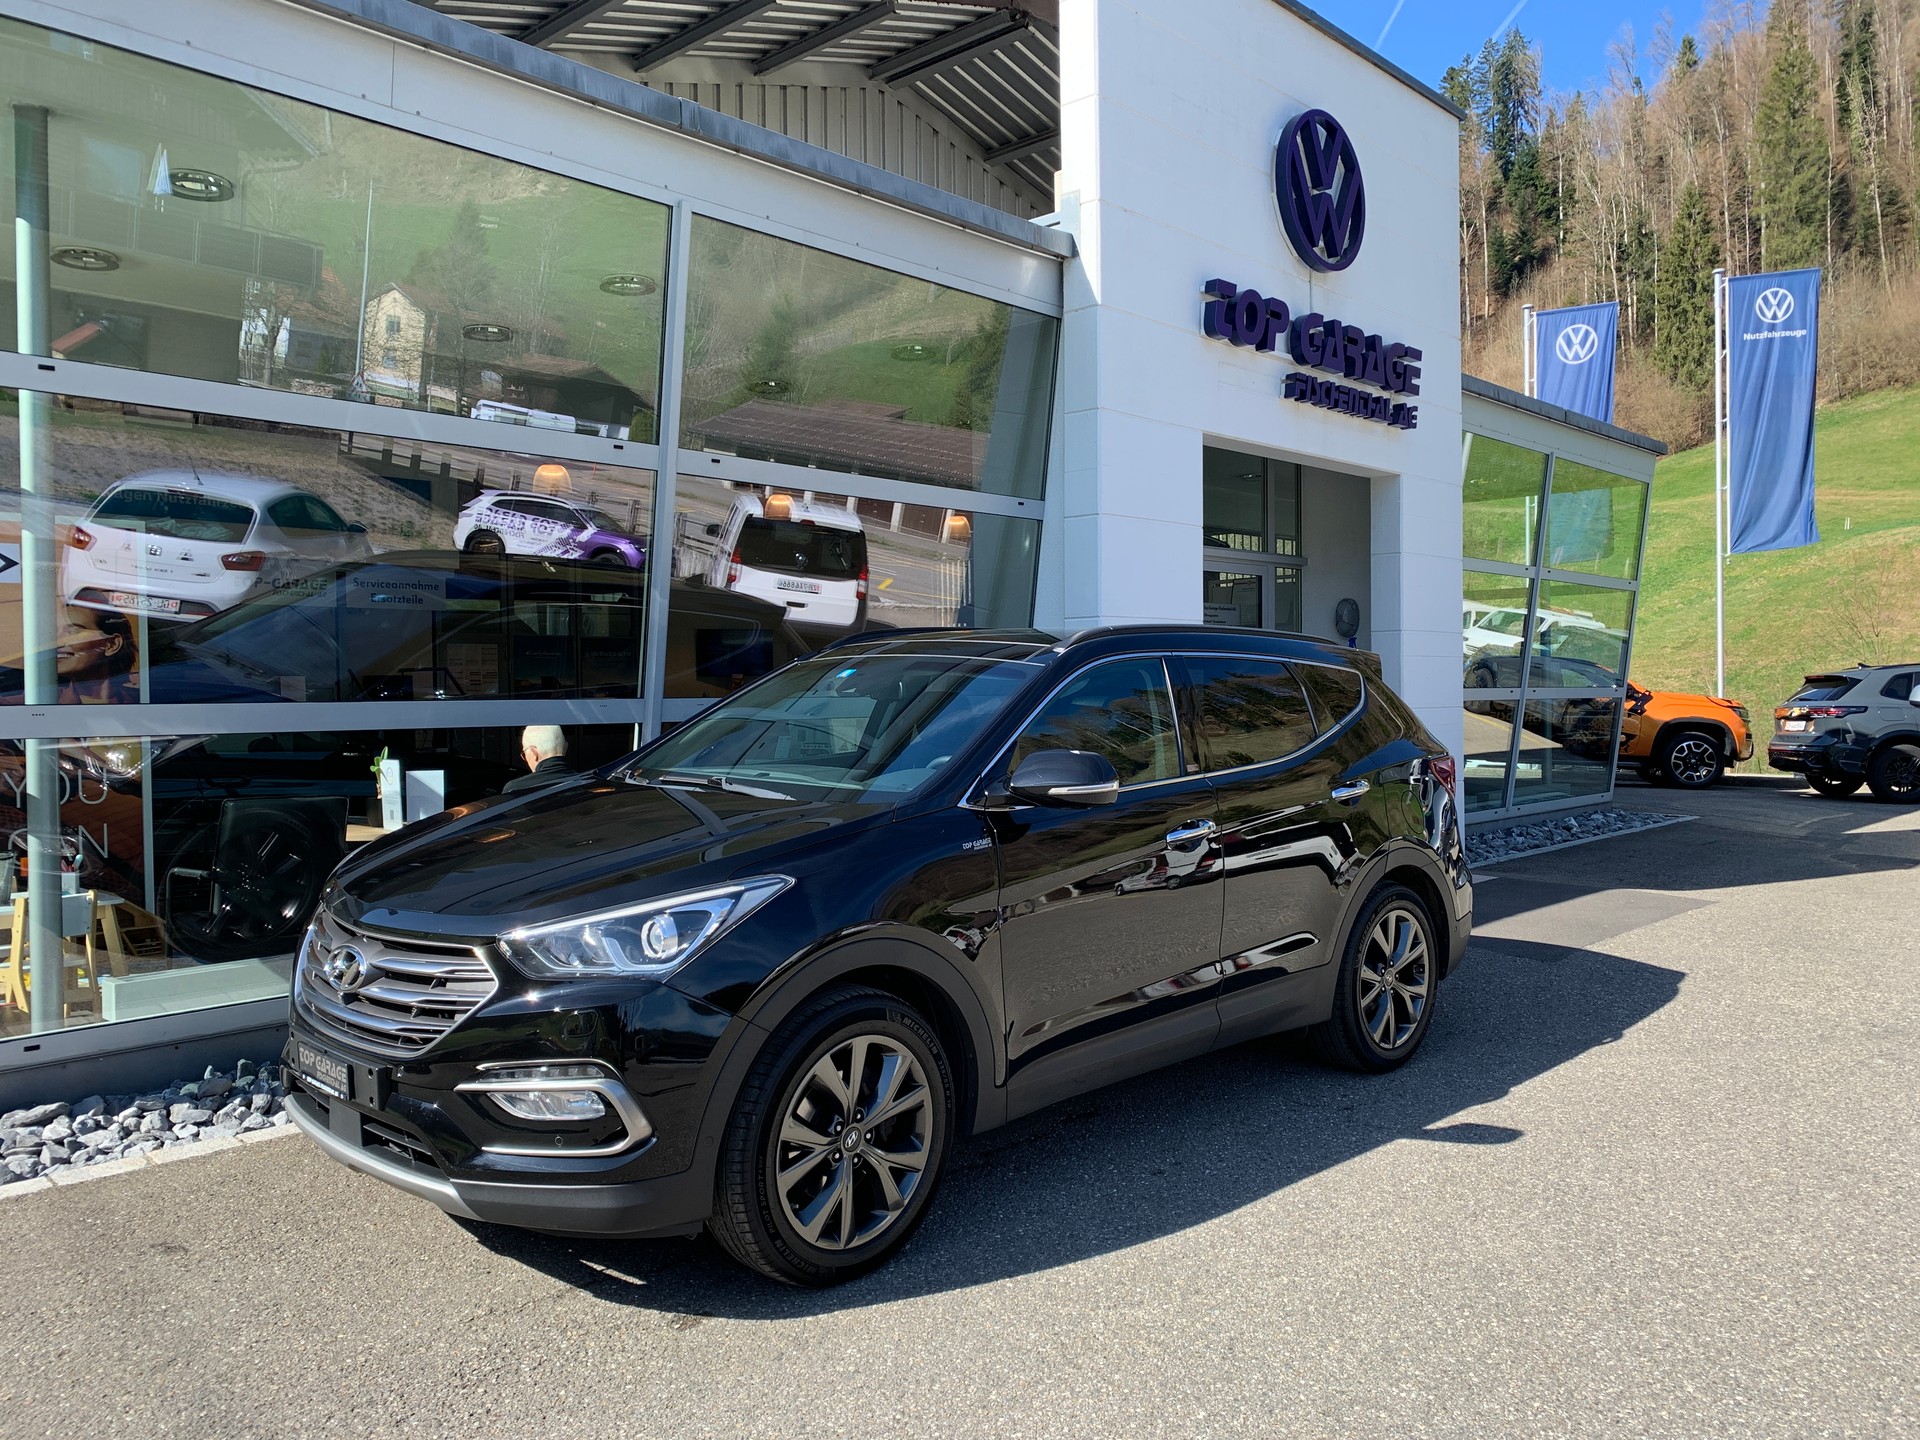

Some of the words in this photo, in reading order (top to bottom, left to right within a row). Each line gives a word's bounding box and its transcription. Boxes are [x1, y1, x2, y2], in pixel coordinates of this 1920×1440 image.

[1203, 278, 1290, 353] TOP
[1290, 312, 1423, 397] GARAGE
[1743, 328, 1808, 341] Nutzfahrzeuge
[353, 577, 440, 591] Serviceannahme
[370, 593, 424, 604] Ersatzteile
[902, 1016, 938, 1055] MICHELIN
[299, 1047, 315, 1067] TOP
[315, 1055, 347, 1083] GARAGE
[758, 1175, 767, 1206] SPORT
[762, 1209, 776, 1233] PILOT
